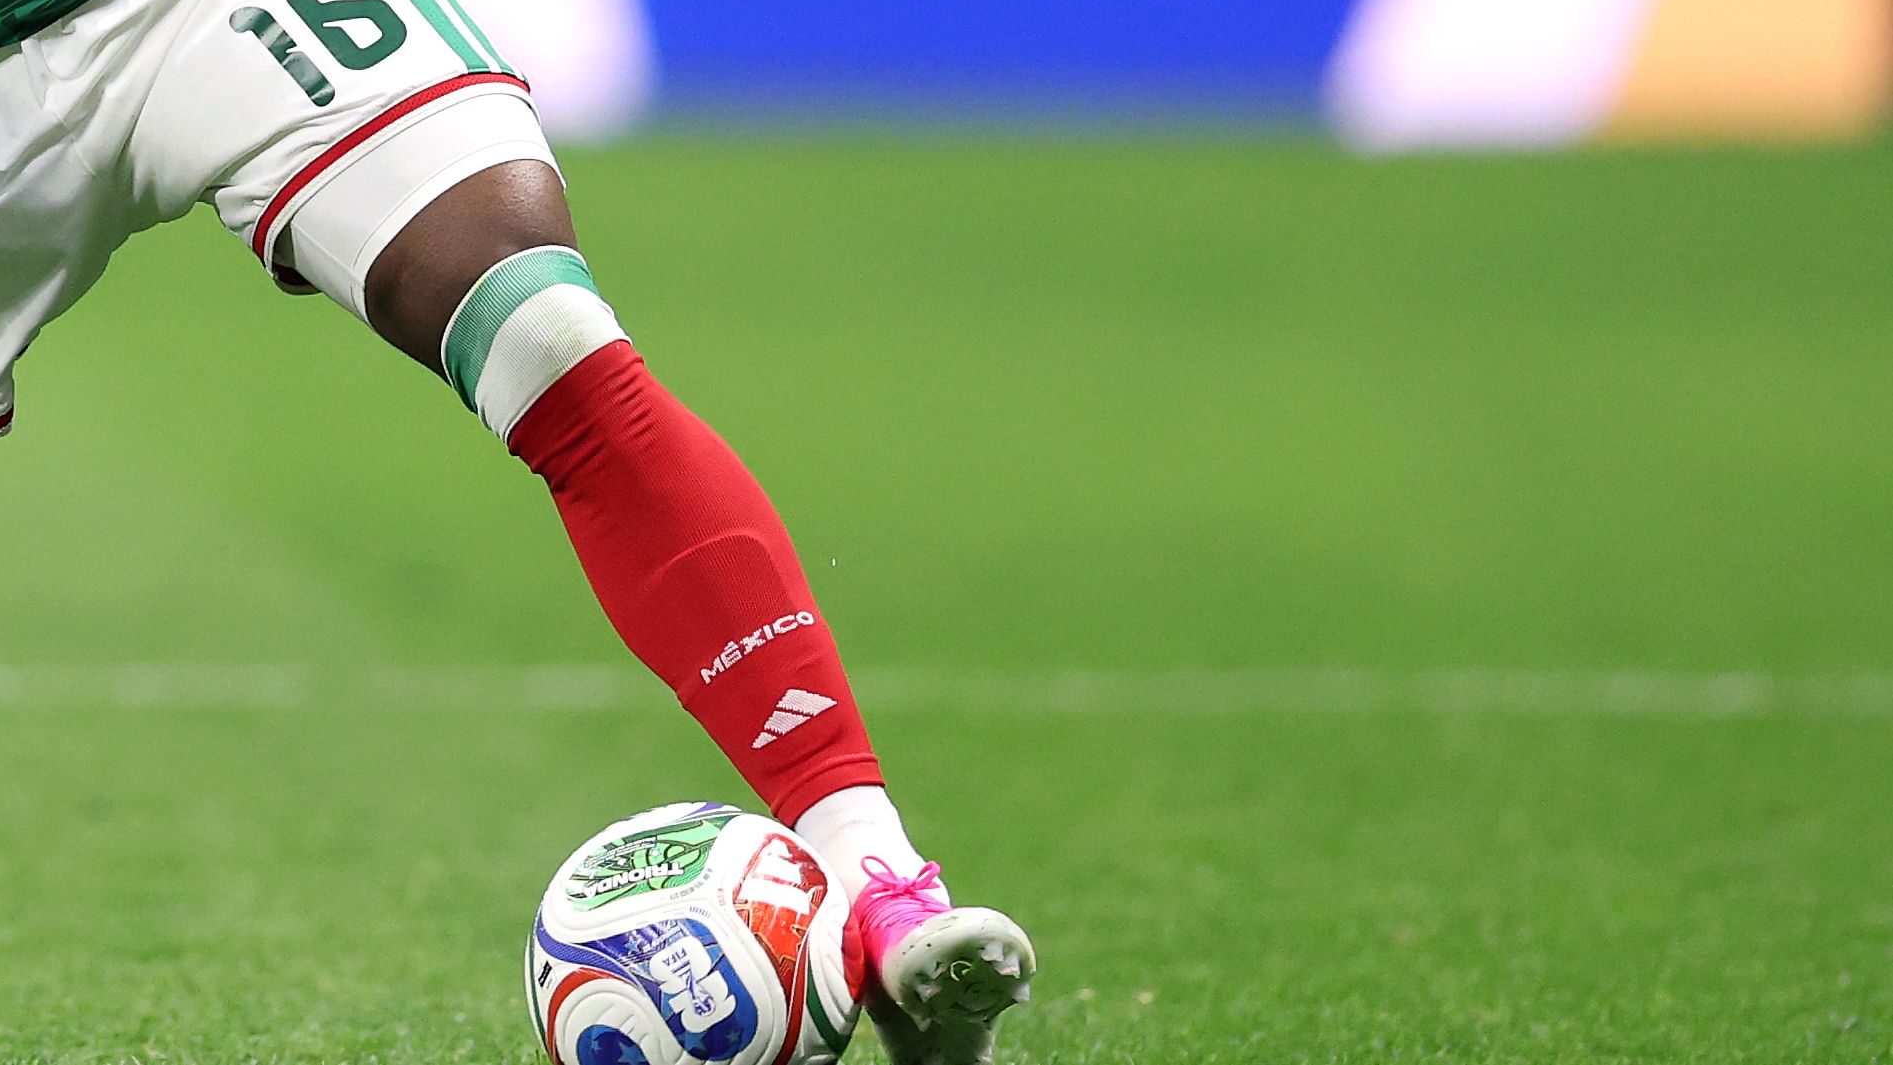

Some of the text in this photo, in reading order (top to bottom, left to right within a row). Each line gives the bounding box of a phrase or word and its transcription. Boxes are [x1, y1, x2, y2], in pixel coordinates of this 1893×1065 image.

[700, 611, 815, 684] MÉXICO
[581, 860, 685, 899] TRIONDA
[662, 947, 687, 966] FIFA
